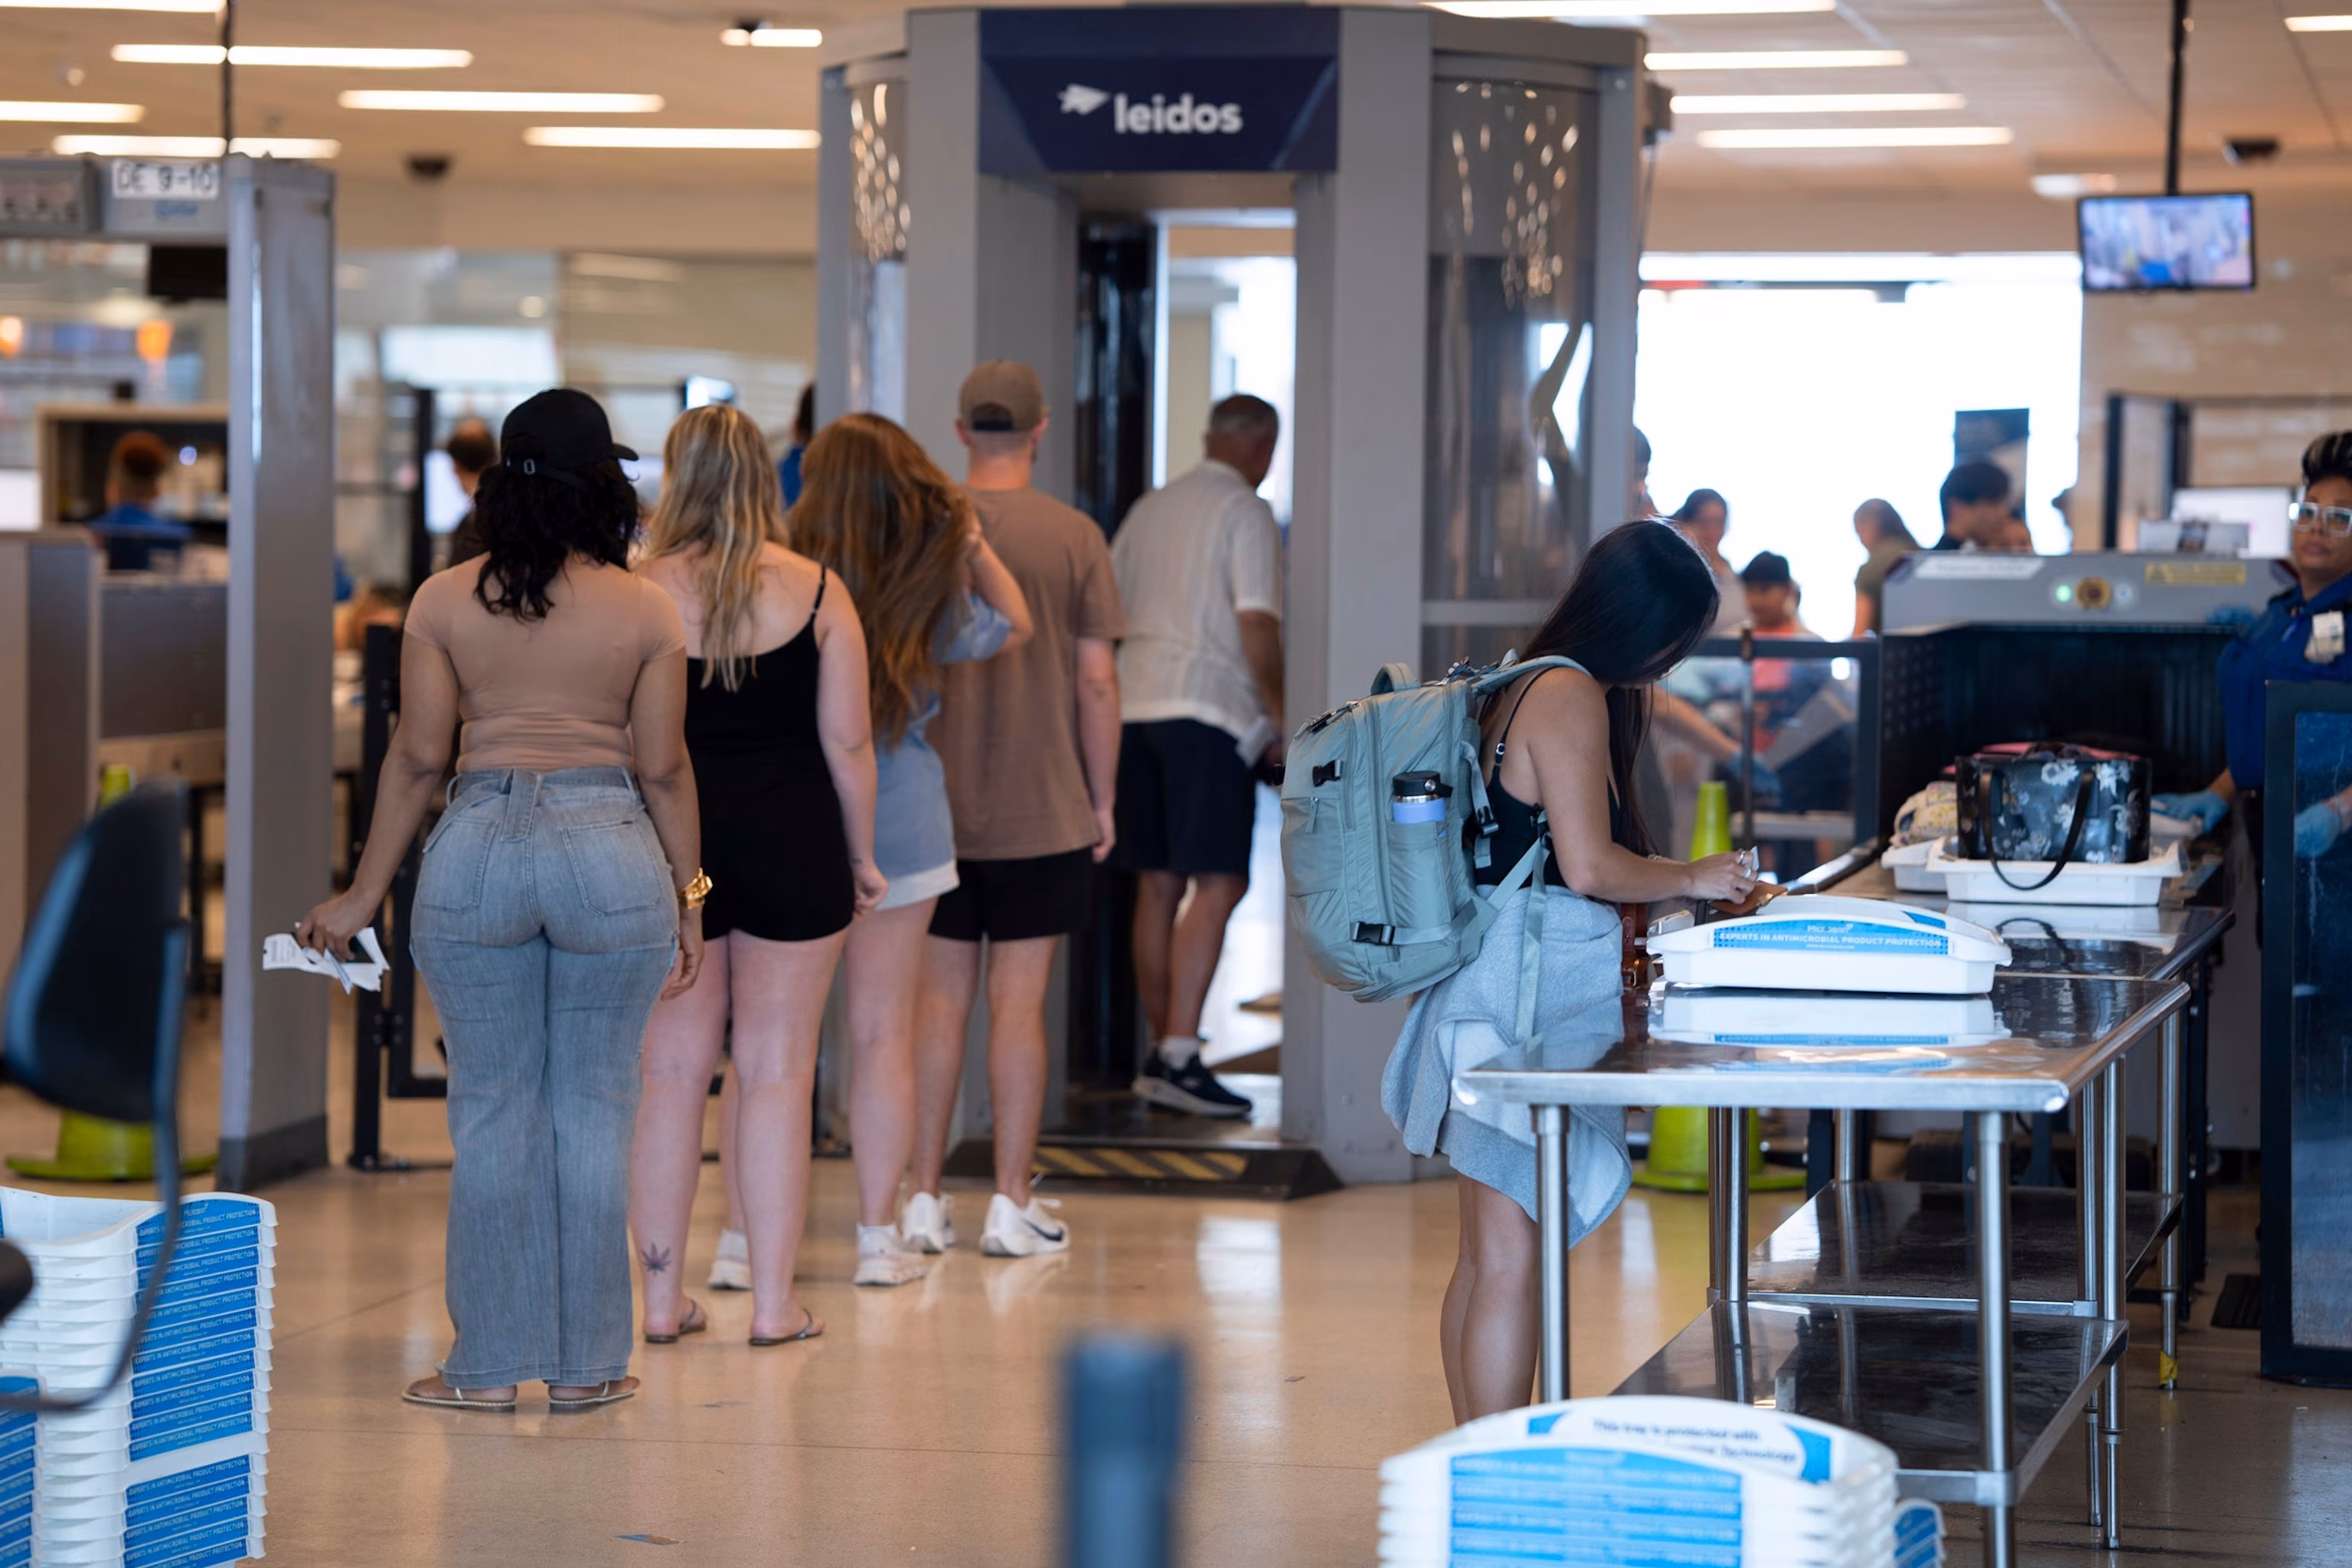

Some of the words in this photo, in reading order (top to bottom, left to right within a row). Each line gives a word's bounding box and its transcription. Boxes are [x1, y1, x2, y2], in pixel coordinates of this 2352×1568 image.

[1114, 93, 1243, 134] leidos
[1719, 932, 1758, 941] EXPERTS
[1771, 933, 1840, 944] ANTIMICROBIAL
[1841, 936, 1883, 945] PRODUCT
[1884, 938, 1942, 947] PROTECTION
